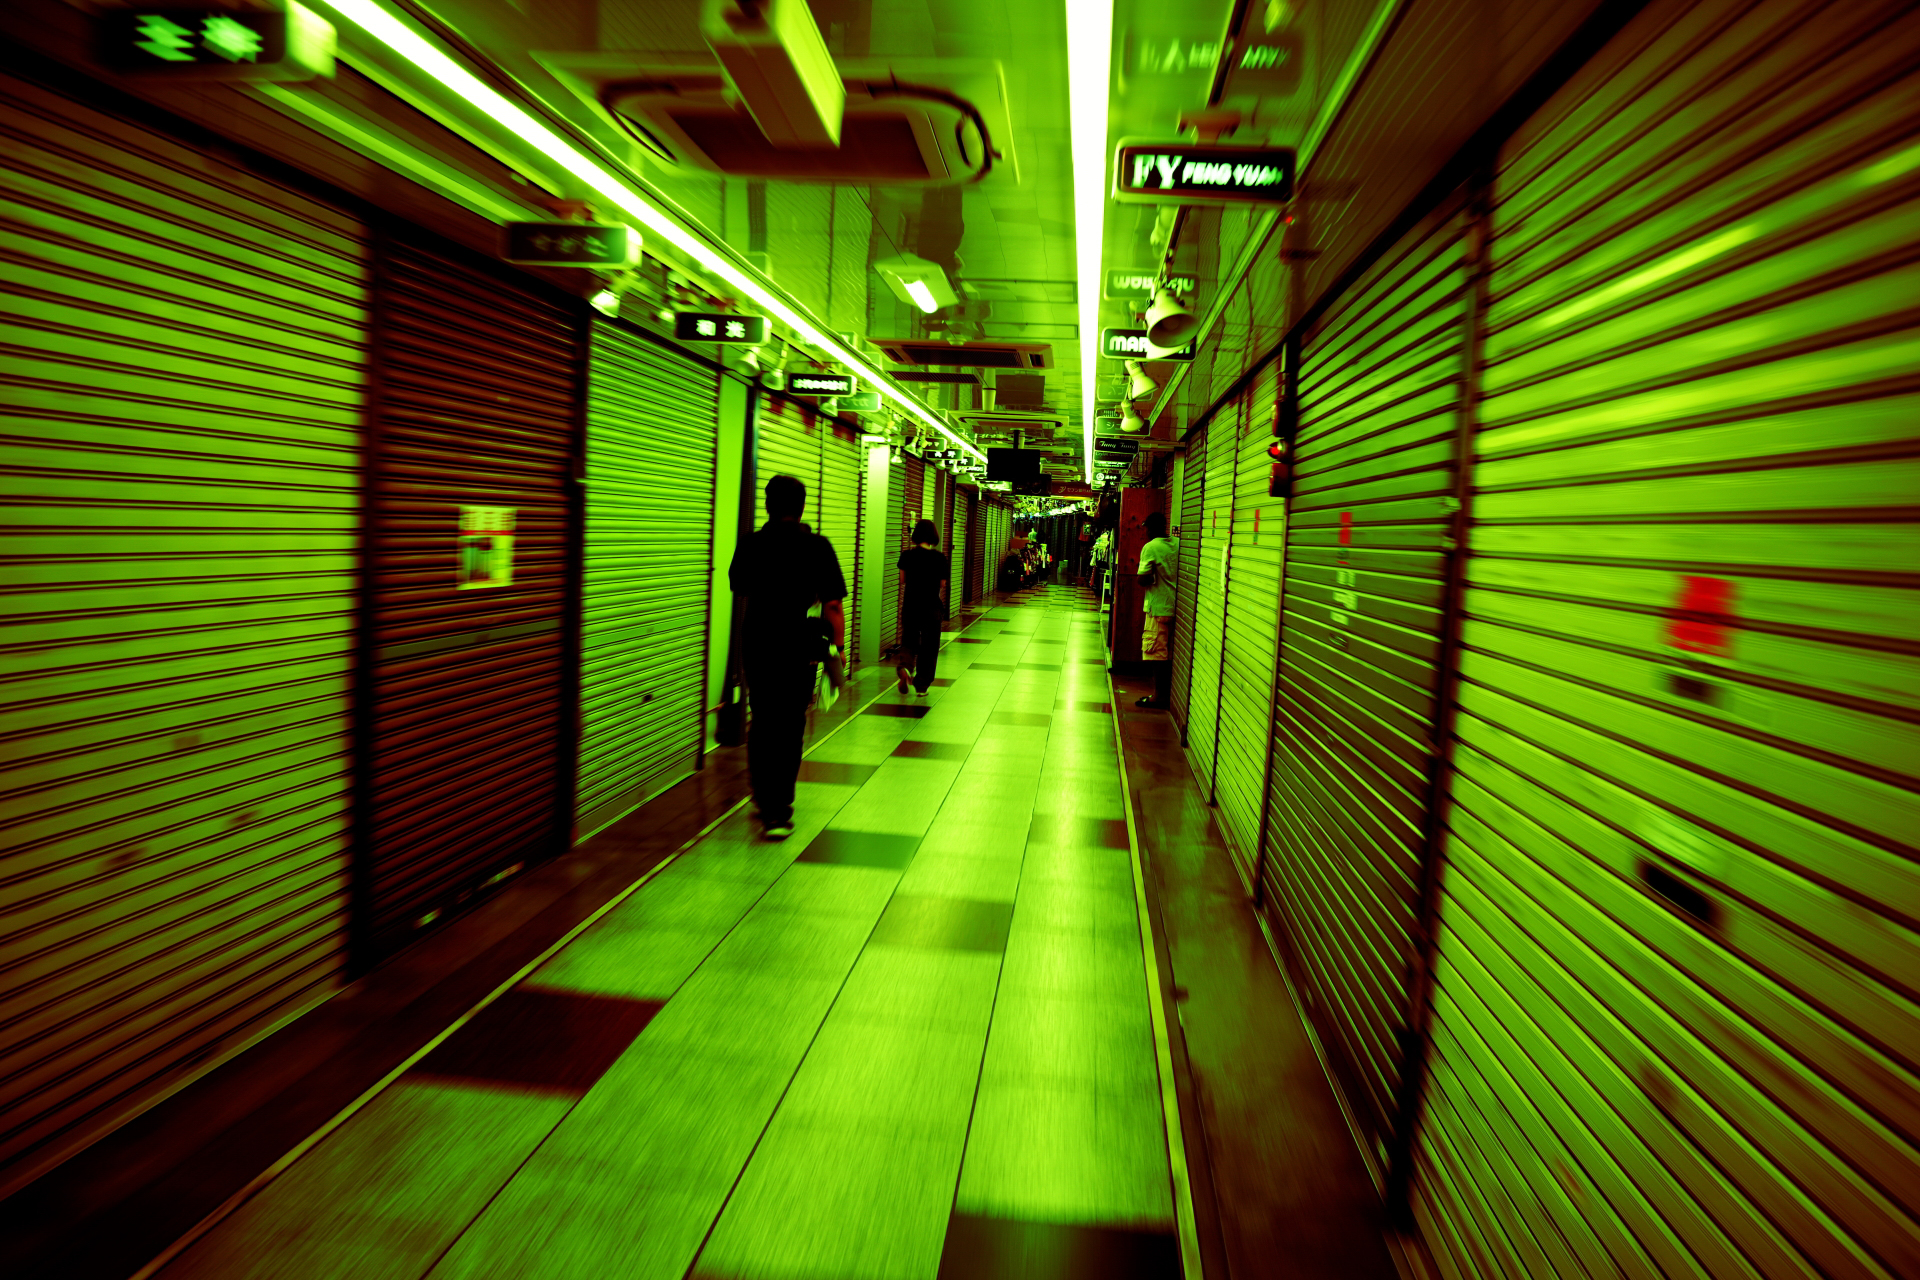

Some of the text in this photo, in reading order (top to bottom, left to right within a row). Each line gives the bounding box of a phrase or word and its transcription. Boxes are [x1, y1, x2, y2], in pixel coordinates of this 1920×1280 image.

[1130, 154, 1284, 190] FY FENG YUAN
